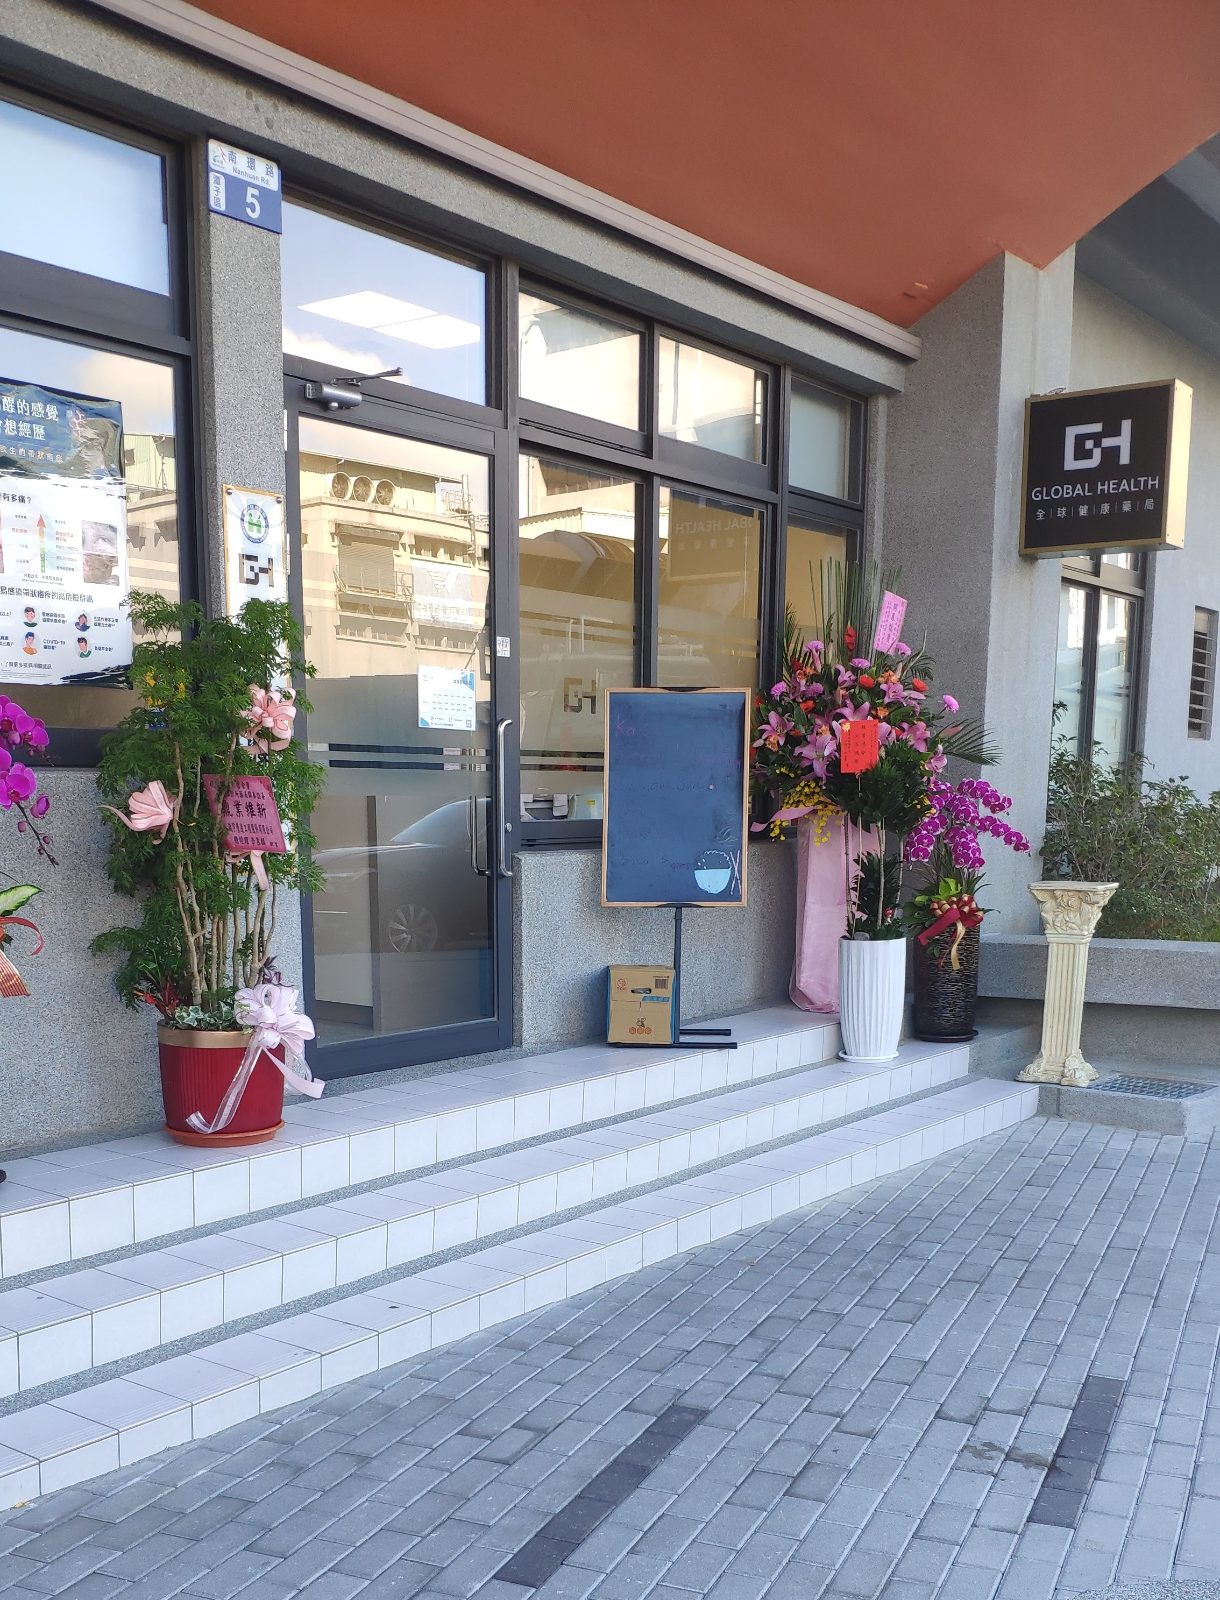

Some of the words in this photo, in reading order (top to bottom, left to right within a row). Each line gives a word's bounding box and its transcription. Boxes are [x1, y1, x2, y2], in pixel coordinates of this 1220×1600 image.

[228, 150, 274, 178] 南環路
[232, 166, 260, 182] Nanhuan
[245, 186, 260, 219] 5
[0, 396, 59, 421] 醒的感覺
[0, 418, 46, 441] 想經歷
[1031, 483, 1093, 501] GLOBAL
[1097, 476, 1159, 495] HEALTH
